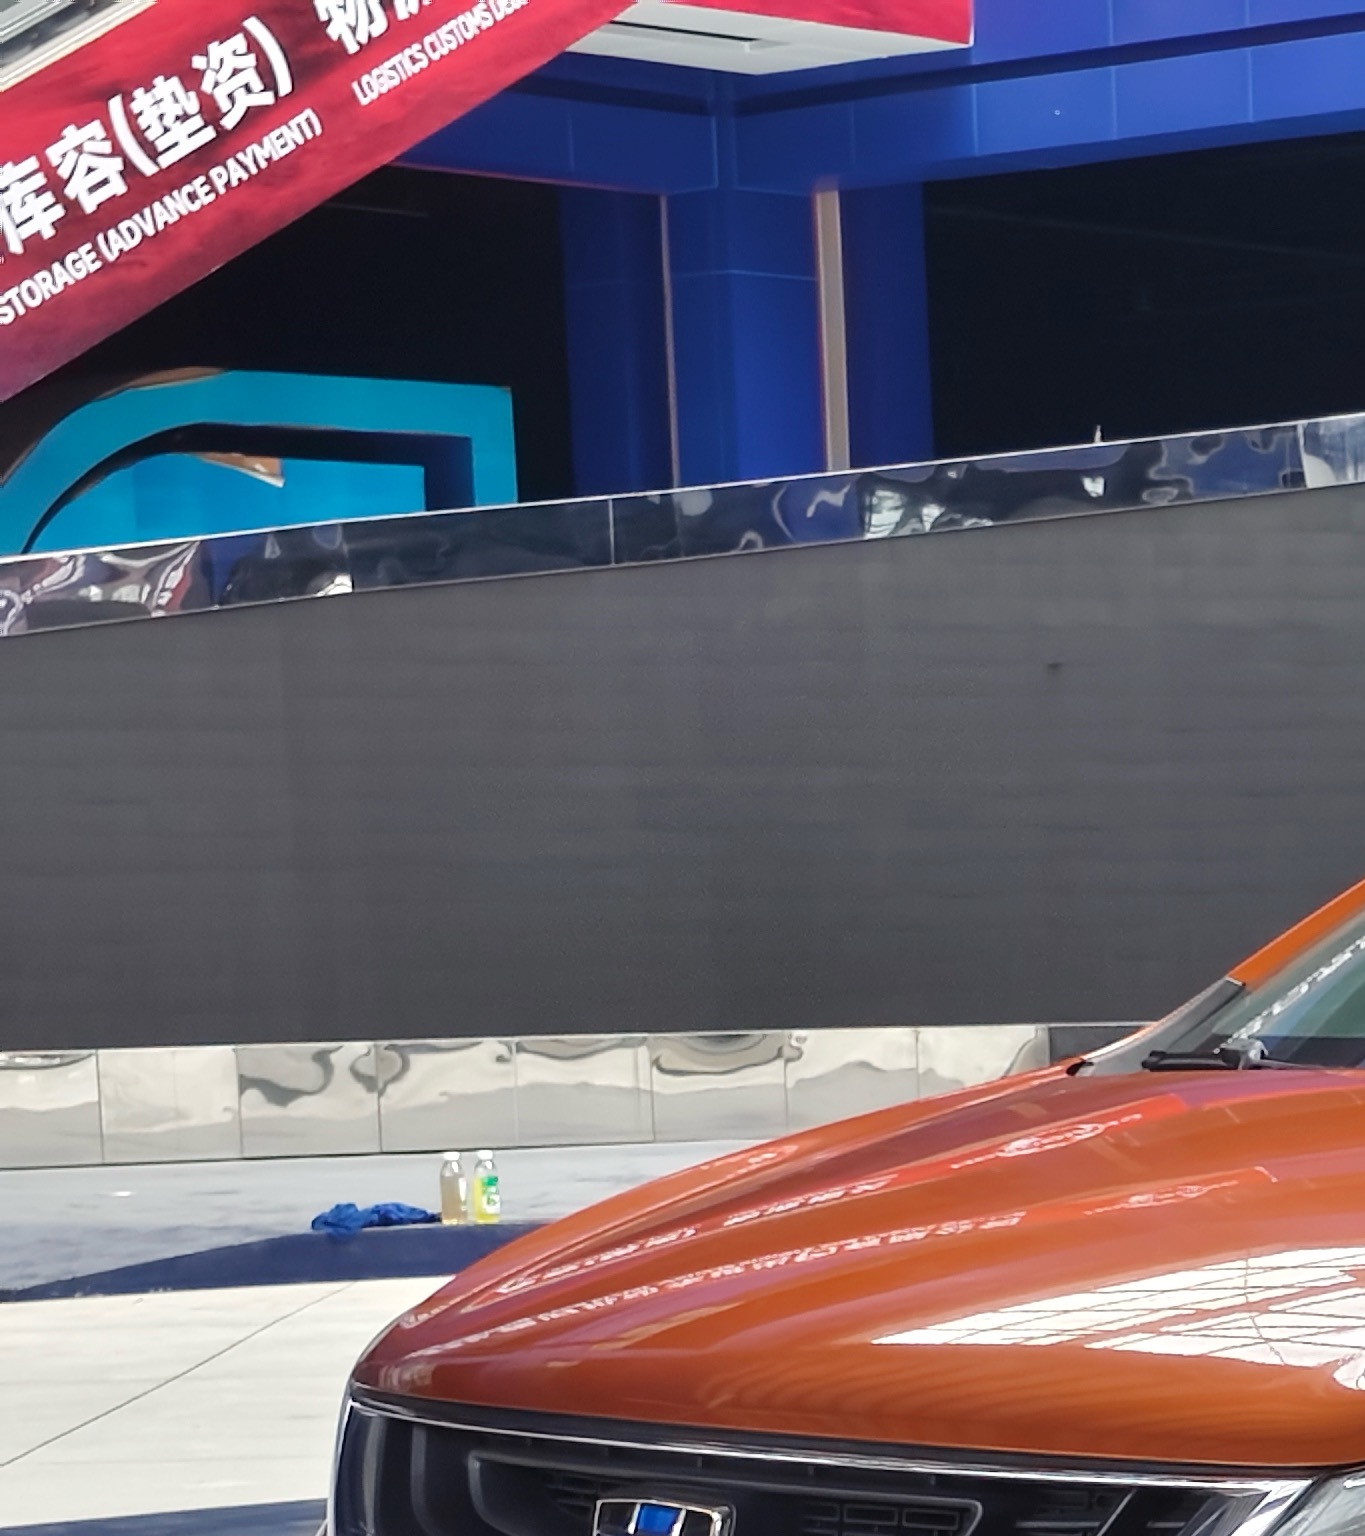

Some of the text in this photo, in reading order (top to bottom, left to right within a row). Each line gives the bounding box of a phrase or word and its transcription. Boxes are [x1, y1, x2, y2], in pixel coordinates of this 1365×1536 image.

[96, 174, 217, 262] (ADVANCE
[208, 107, 323, 195] PAYMENT)
[351, 42, 429, 106] LOGISTICS
[422, 2, 495, 61] CUSTOMS
